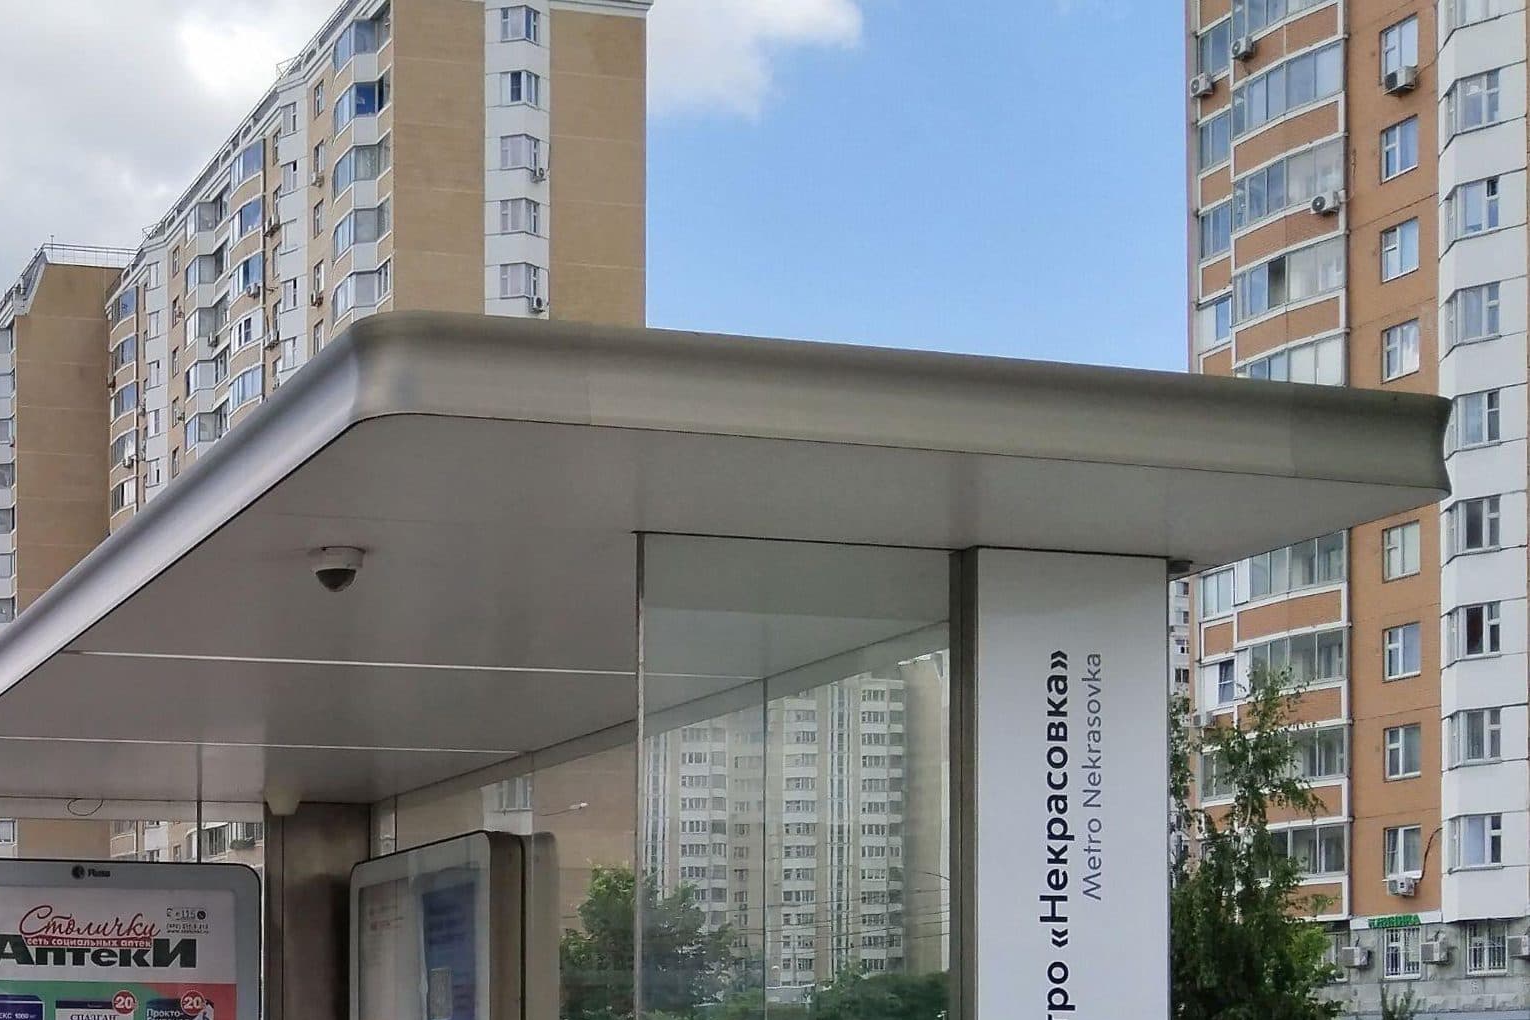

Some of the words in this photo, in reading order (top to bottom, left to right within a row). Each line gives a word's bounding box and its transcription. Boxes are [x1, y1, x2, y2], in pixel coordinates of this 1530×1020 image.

[1082, 653, 1102, 807] Nekrasovka
[1039, 649, 1074, 949] «Некрасовка»
[1082, 817, 1102, 900] Metro
[19, 904, 161, 936] Столички
[27, 938, 49, 947] сеть
[51, 937, 118, 948] социальных
[120, 938, 152, 948] аптек
[146, 1008, 184, 1018] Прокто-
